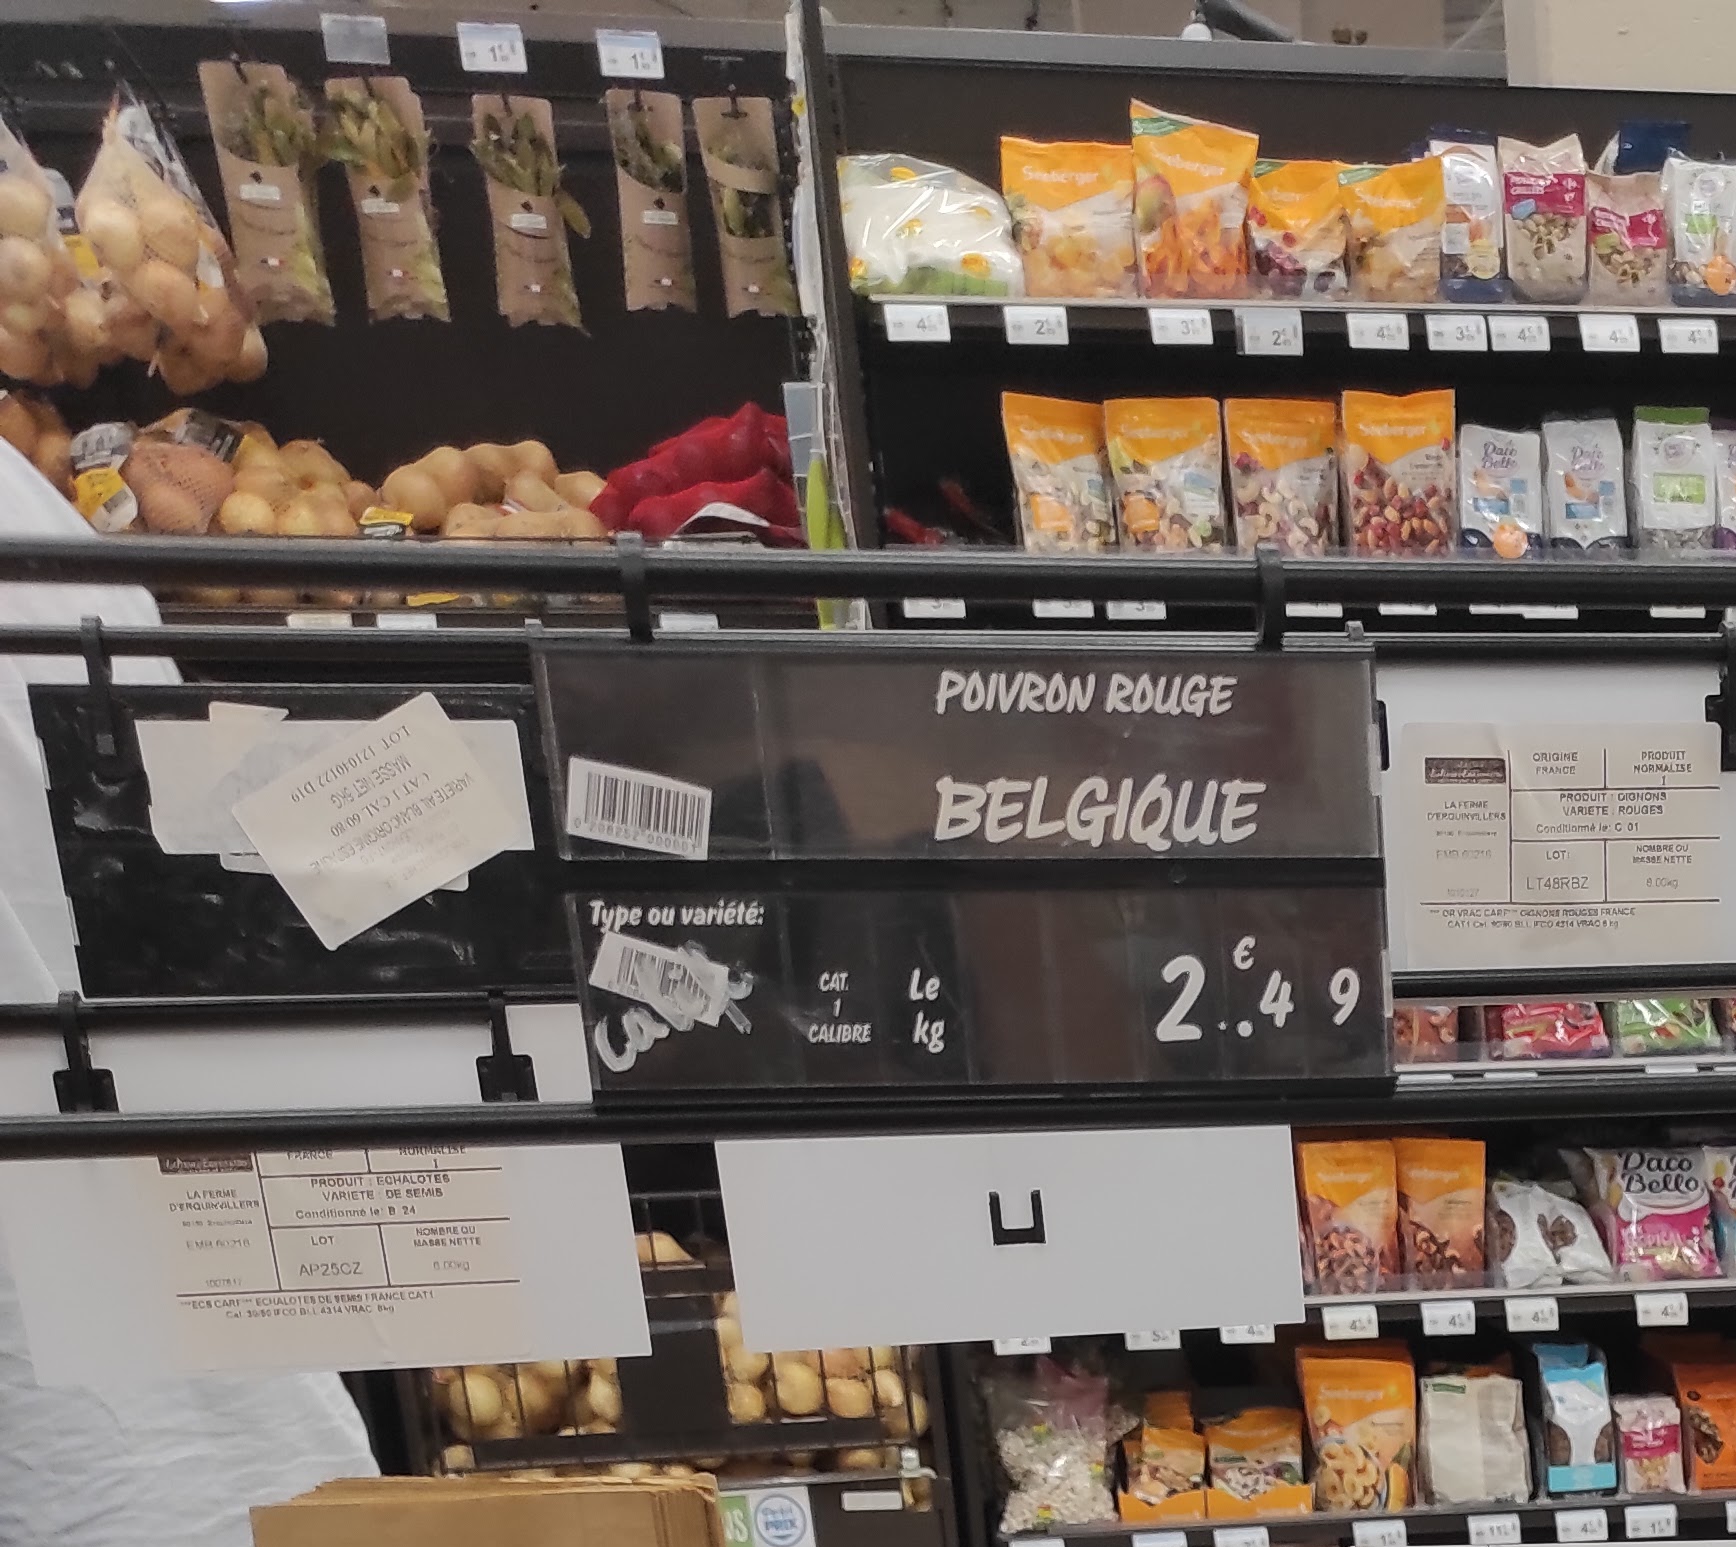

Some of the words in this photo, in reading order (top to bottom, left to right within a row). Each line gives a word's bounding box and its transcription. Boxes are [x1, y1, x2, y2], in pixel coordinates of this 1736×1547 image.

[935, 669, 1096, 714] POIVRON
[1104, 673, 1238, 717] ROUGE
[1641, 750, 1687, 761] PRODUIT
[1535, 765, 1576, 775] FRANCE
[1633, 764, 1692, 774] NORMALISE
[1559, 792, 1607, 803] PRODUIT
[934, 774, 1267, 852] BELGIQUE
[1562, 806, 1609, 816] VARIETE
[1618, 804, 1664, 815] ROUGES
[589, 899, 642, 935] Type
[647, 905, 675, 927] ou
[680, 898, 765, 927] variété:
[909, 967, 941, 1001] Le
[808, 1022, 872, 1044] CALIBRE
[913, 1010, 945, 1053] kg
[1620, 1151, 1694, 1173] Daco
[310, 1176, 364, 1188] PRODUIT
[1620, 1173, 1700, 1195] Bello
[322, 1190, 375, 1202] VARIETE
[385, 1188, 402, 1199] DE
